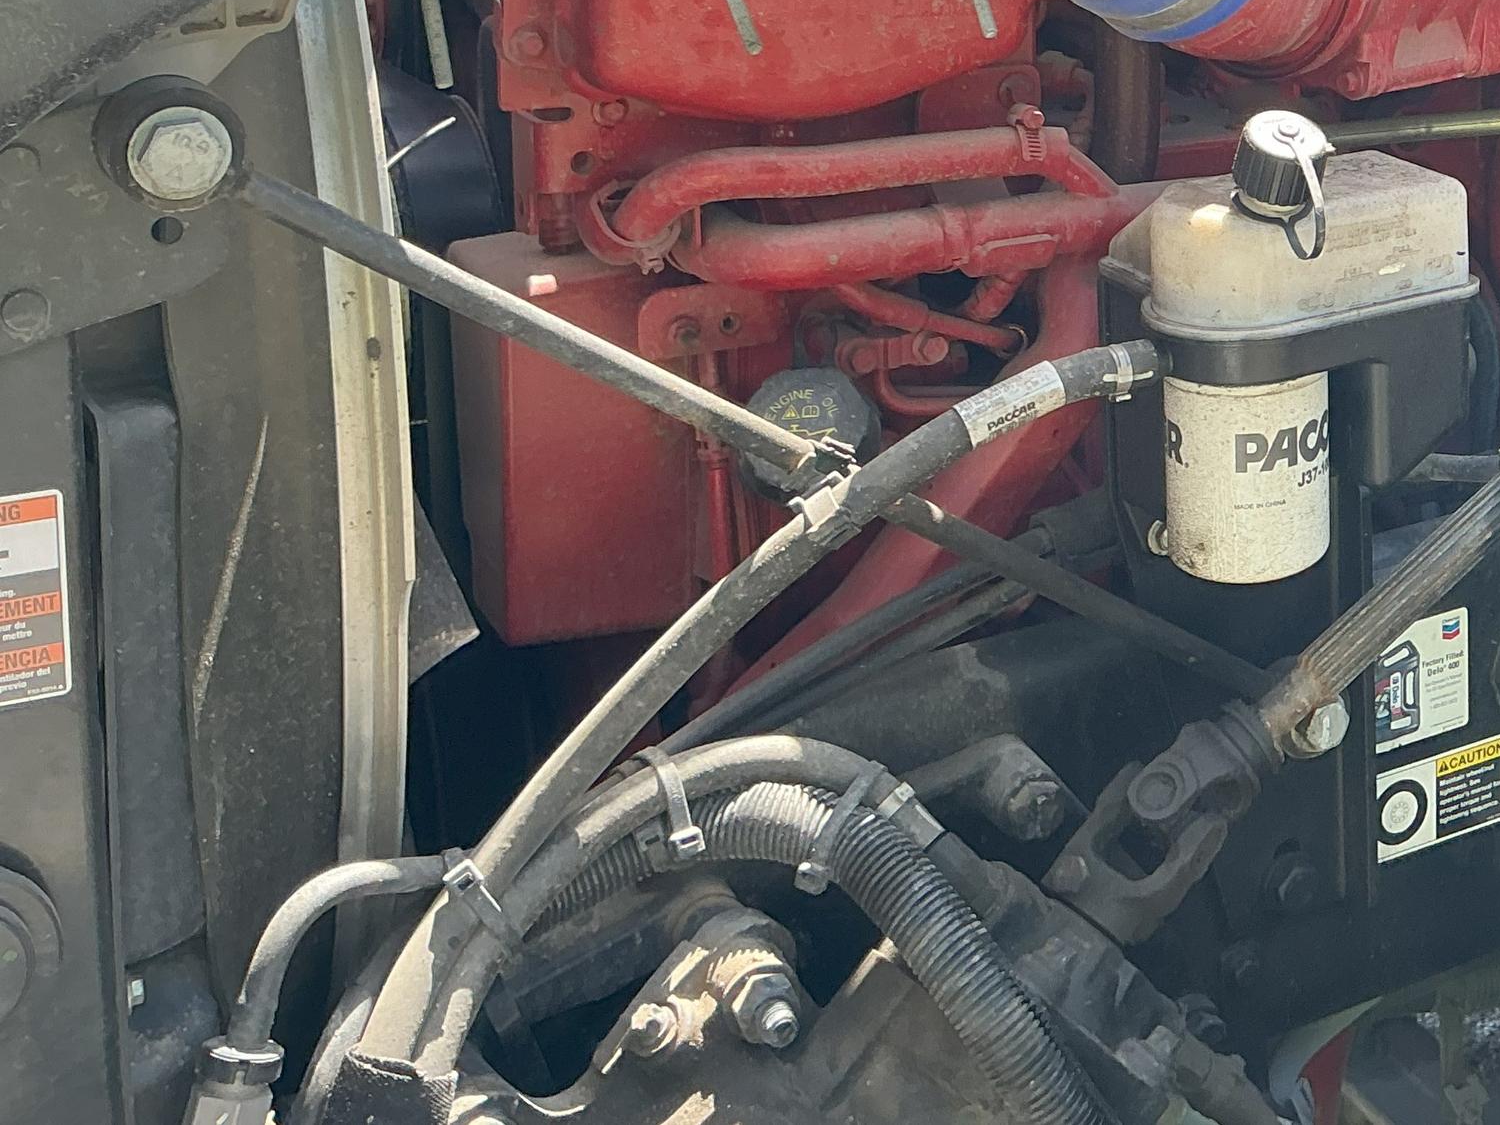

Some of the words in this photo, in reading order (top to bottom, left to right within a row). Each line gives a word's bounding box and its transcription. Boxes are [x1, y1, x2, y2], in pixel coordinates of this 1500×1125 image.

[765, 388, 815, 421] ENGINE
[821, 396, 840, 418] OIL
[986, 401, 1037, 431] PACCAR
[1234, 503, 1254, 511] MADE
[1256, 502, 1264, 510] IN
[1265, 498, 1287, 509] CHINA
[1422, 656, 1444, 669] Factory
[1448, 661, 1460, 670] 400
[1391, 685, 1399, 704] Delo
